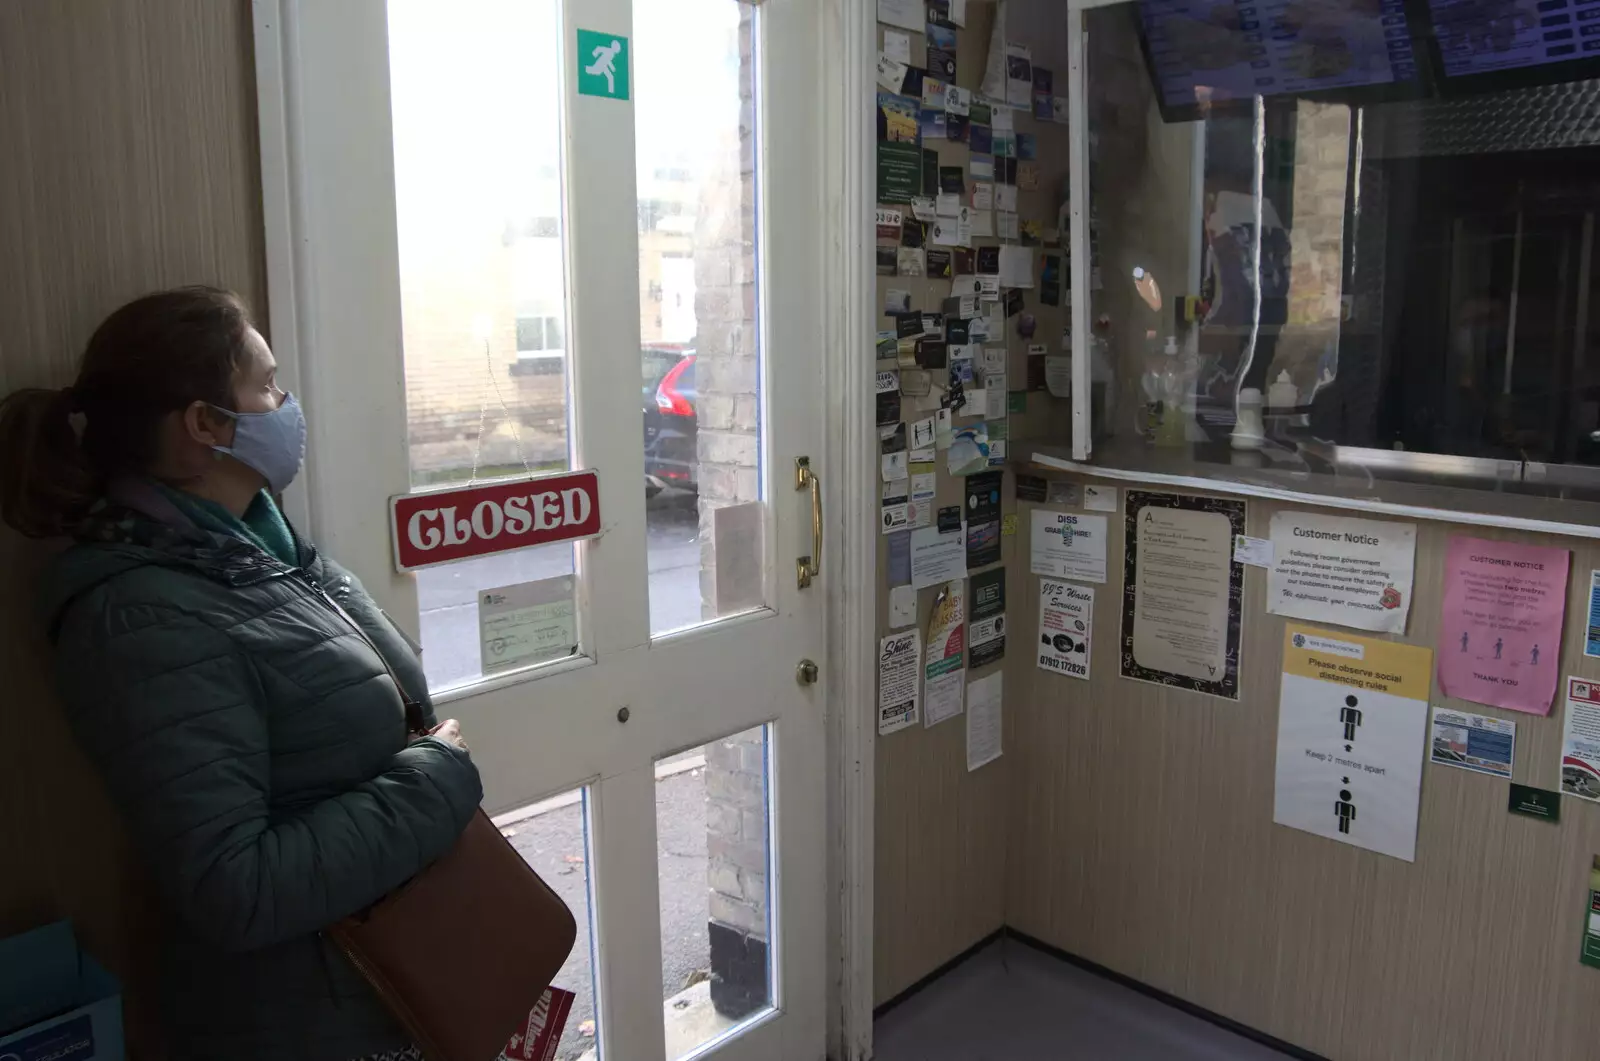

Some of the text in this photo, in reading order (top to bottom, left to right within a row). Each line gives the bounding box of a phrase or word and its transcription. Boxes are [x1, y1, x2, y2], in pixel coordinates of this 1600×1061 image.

[407, 487, 591, 550] CLOSED
[1057, 515, 1078, 524] DISS
[1293, 526, 1379, 546] Customer Notice
[1290, 550, 1380, 567] Following recent government
[1470, 555, 1544, 570] CUSTOMER NOTICE
[1290, 568, 1300, 576] the
[1302, 571, 1321, 579] phone
[1366, 579, 1385, 588] safety
[1312, 562, 1332, 570] please
[1334, 564, 1361, 574] consider
[1362, 568, 1390, 579] ordering
[1300, 580, 1330, 588] customers
[1504, 584, 1519, 592] two
[1520, 587, 1546, 596] metres
[944, 594, 963, 611] BABY
[1066, 588, 1092, 602] Waste
[1050, 597, 1082, 612] Services
[1040, 656, 1086, 675] 07912 172826
[1308, 657, 1402, 683] Please observe social
[1319, 672, 1388, 691] distancing rules
[1472, 672, 1518, 686] THANK YOU
[1306, 749, 1386, 775] Keep 2 metres apart
